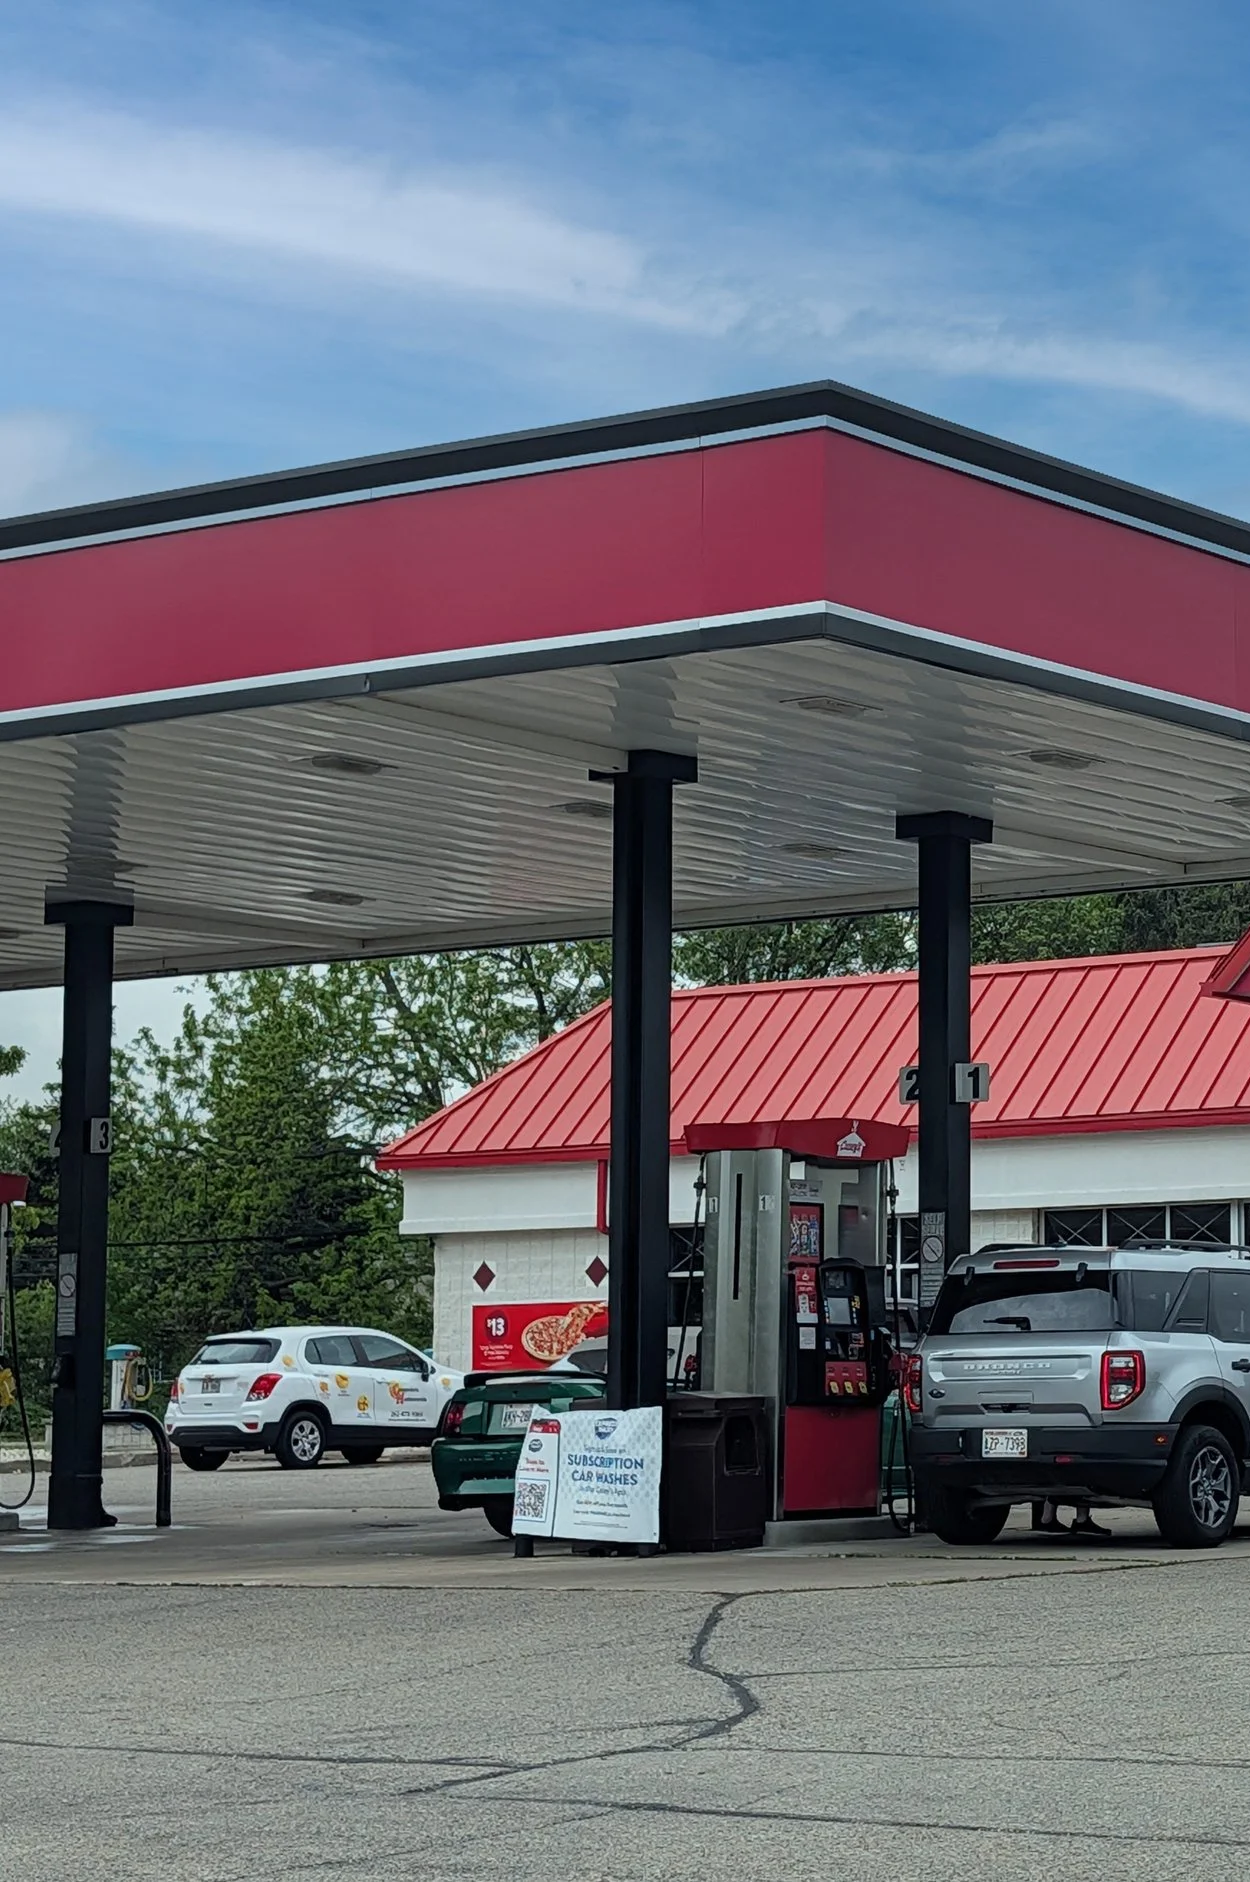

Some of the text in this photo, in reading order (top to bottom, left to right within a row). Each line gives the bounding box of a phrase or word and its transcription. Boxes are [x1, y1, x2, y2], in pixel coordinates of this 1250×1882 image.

[905, 1069, 919, 1101] 2
[967, 1066, 980, 1099] 1
[100, 1121, 110, 1150] 3
[963, 1362, 1051, 1371] BRONCO
[567, 1453, 645, 1470] SUBSCRIPTION
[571, 1469, 638, 1486] CAR WASHES
